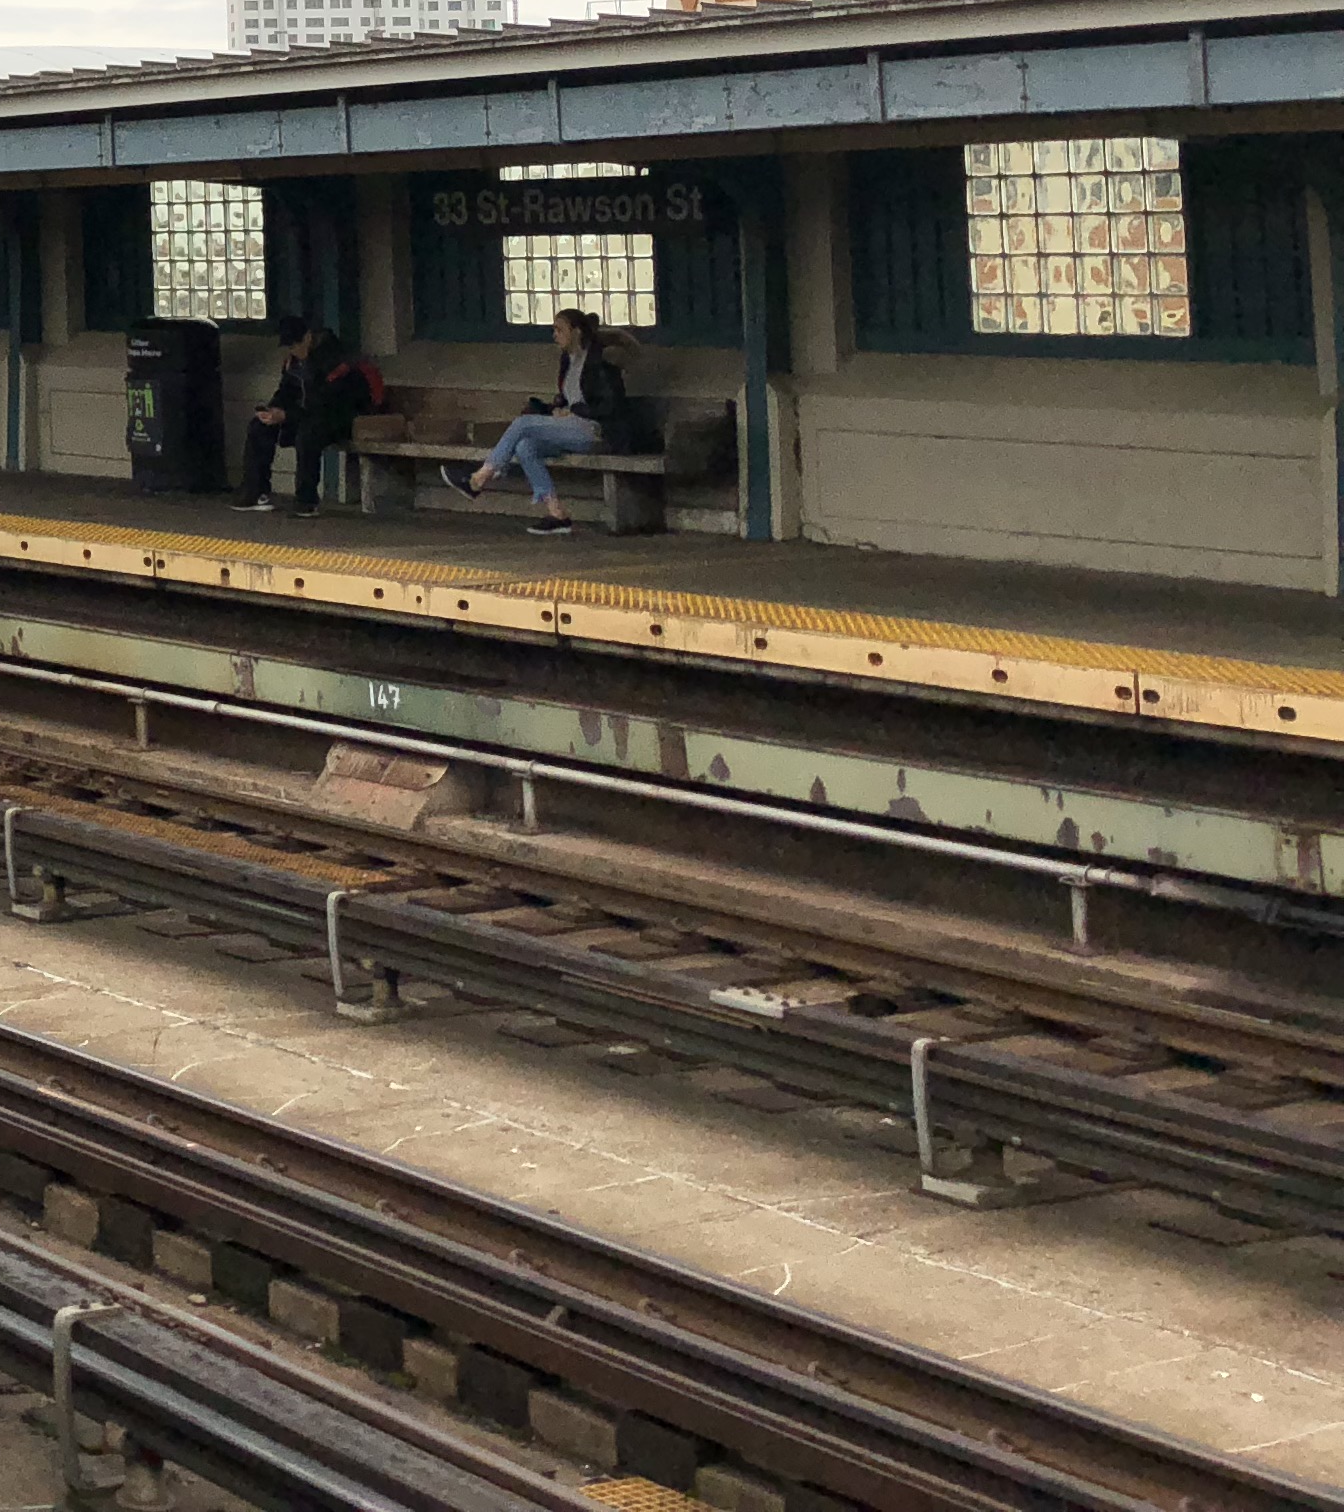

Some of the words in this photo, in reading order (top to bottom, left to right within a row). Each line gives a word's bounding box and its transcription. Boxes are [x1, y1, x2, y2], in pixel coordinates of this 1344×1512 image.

[432, 191, 469, 226] 33
[476, 187, 656, 225] St-Rawson
[666, 182, 705, 222] St
[368, 680, 401, 710] 147
